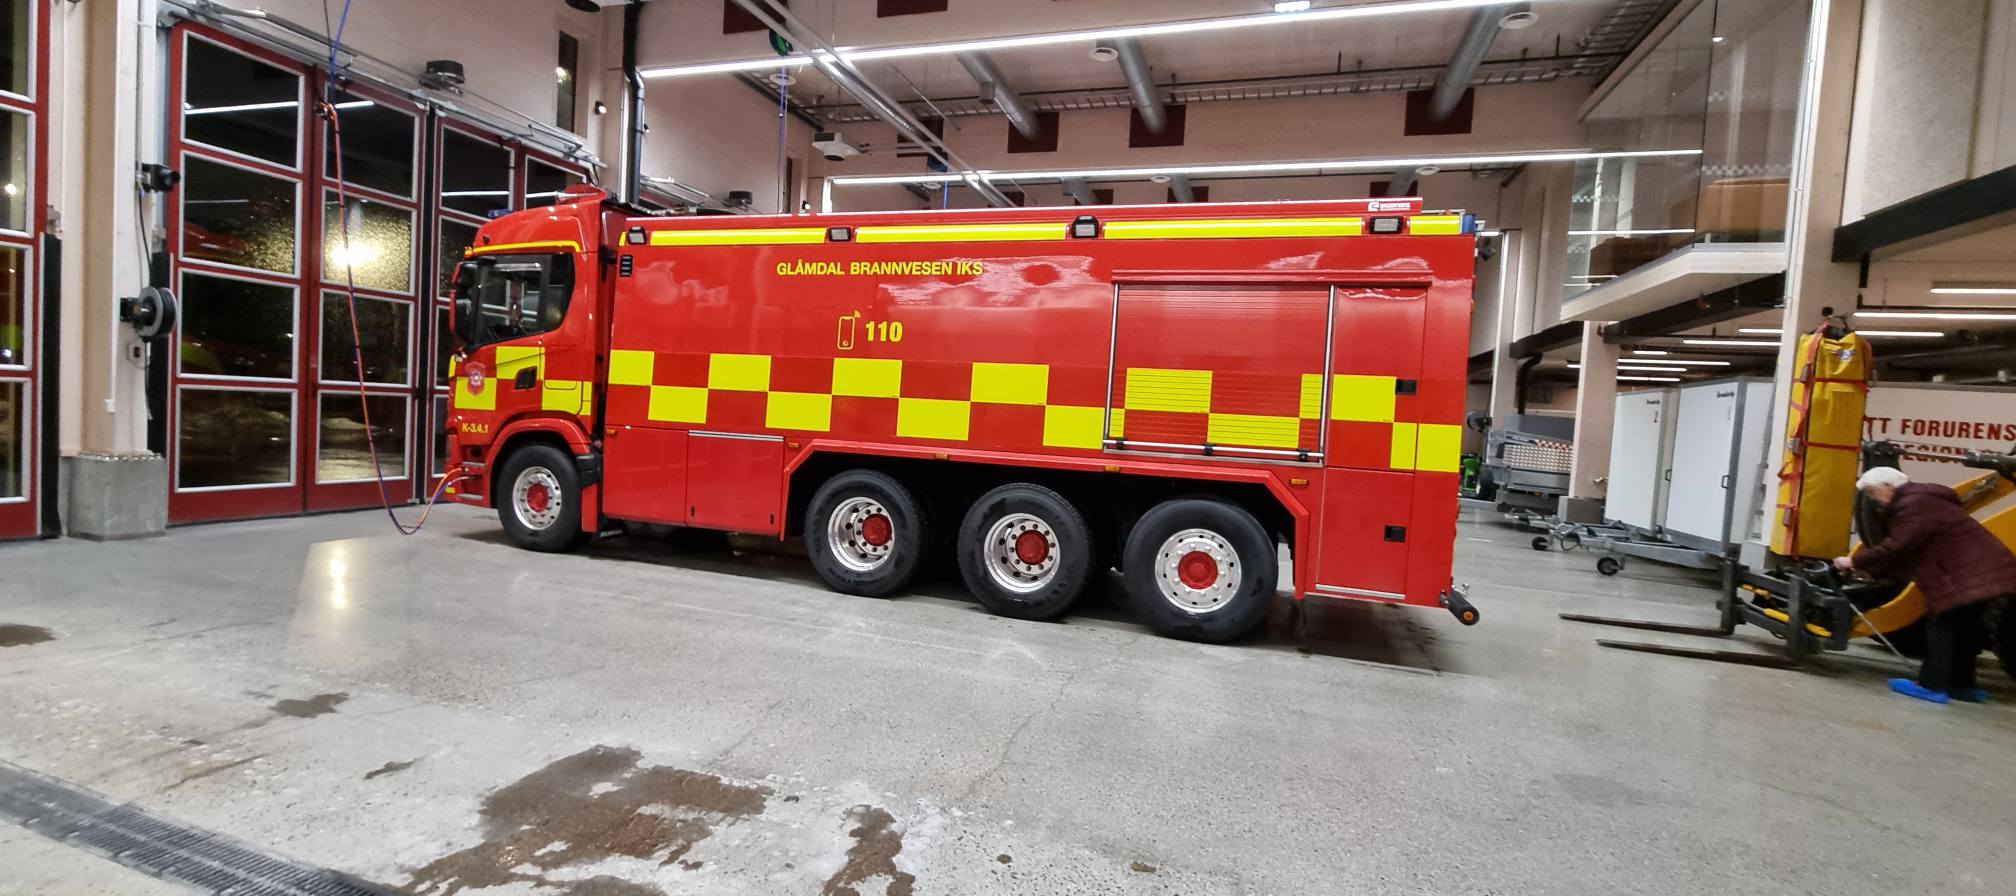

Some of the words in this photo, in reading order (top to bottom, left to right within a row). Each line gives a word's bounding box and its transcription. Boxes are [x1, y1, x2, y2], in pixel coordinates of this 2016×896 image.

[776, 259, 845, 276] GLÅMDAL
[850, 261, 952, 276] BRANNVESEN
[957, 261, 984, 276] IKS
[865, 321, 903, 342] 110
[1901, 418, 2016, 441] FORURENS
